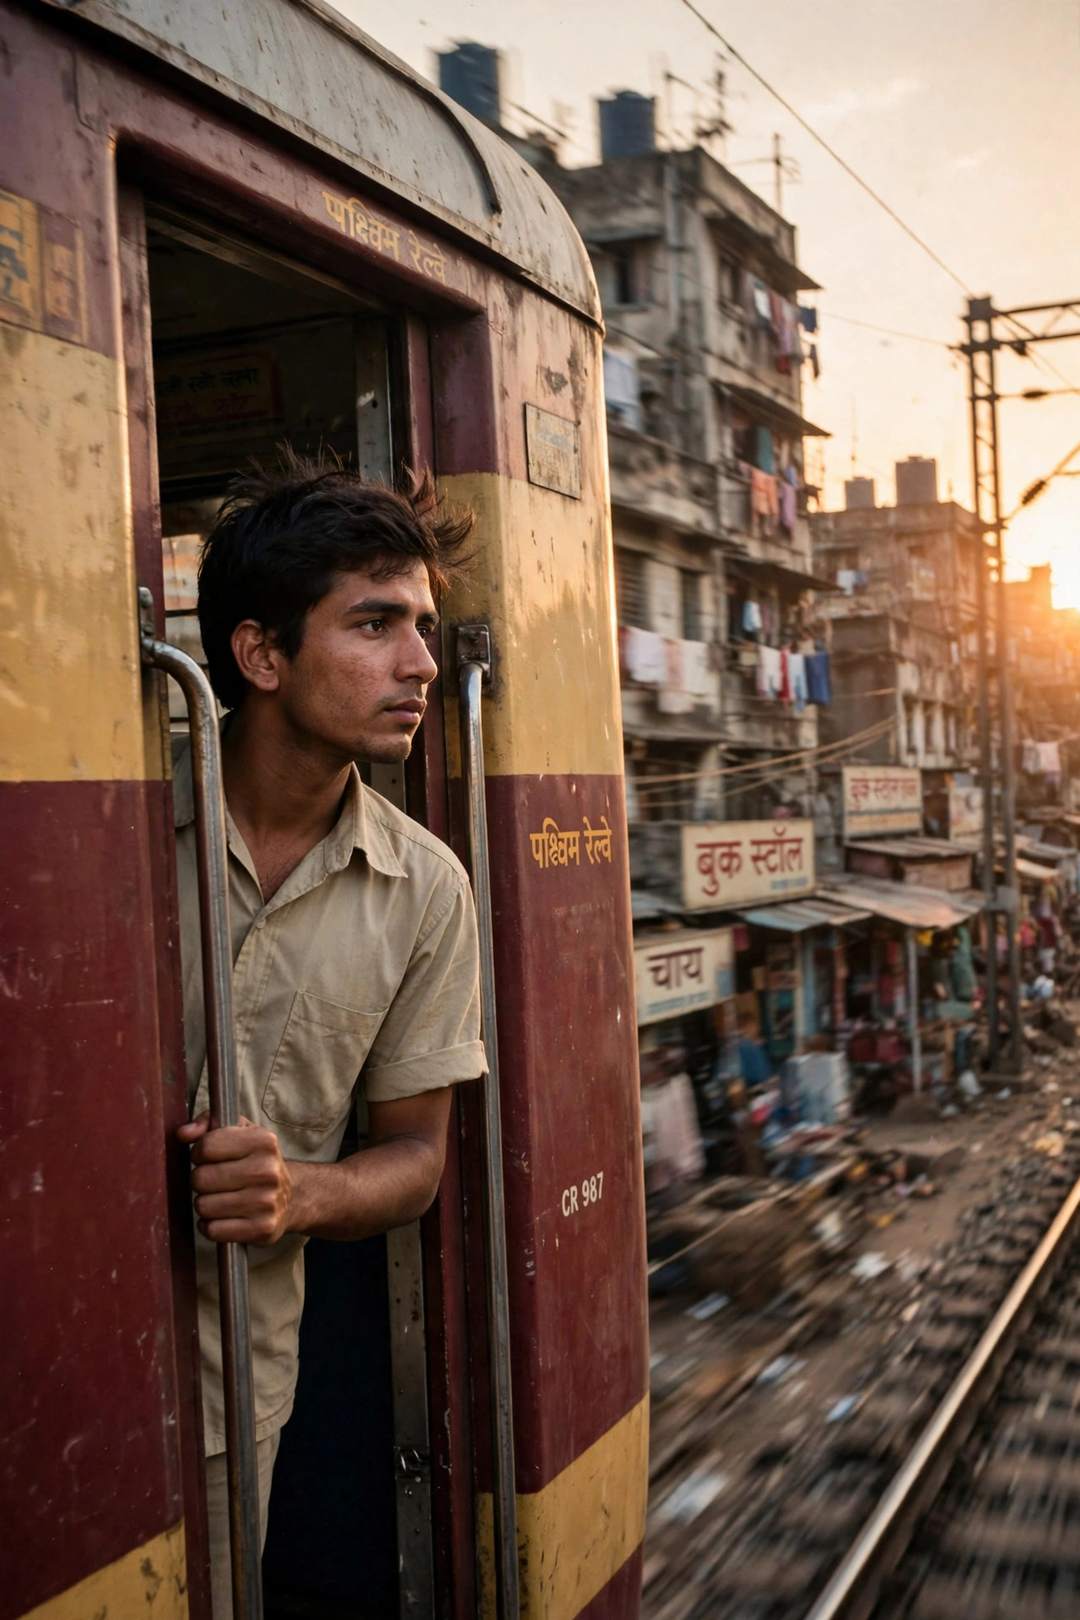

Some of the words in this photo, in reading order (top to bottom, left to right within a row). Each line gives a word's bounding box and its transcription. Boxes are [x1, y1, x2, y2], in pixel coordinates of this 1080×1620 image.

[582, 815, 613, 865] रेल्वे
[695, 840, 742, 897] बुक
[749, 825, 803, 876] स्टॉल
[646, 946, 705, 990] चाय
[561, 1185, 579, 1217] CR
[581, 1170, 604, 1207] 987
